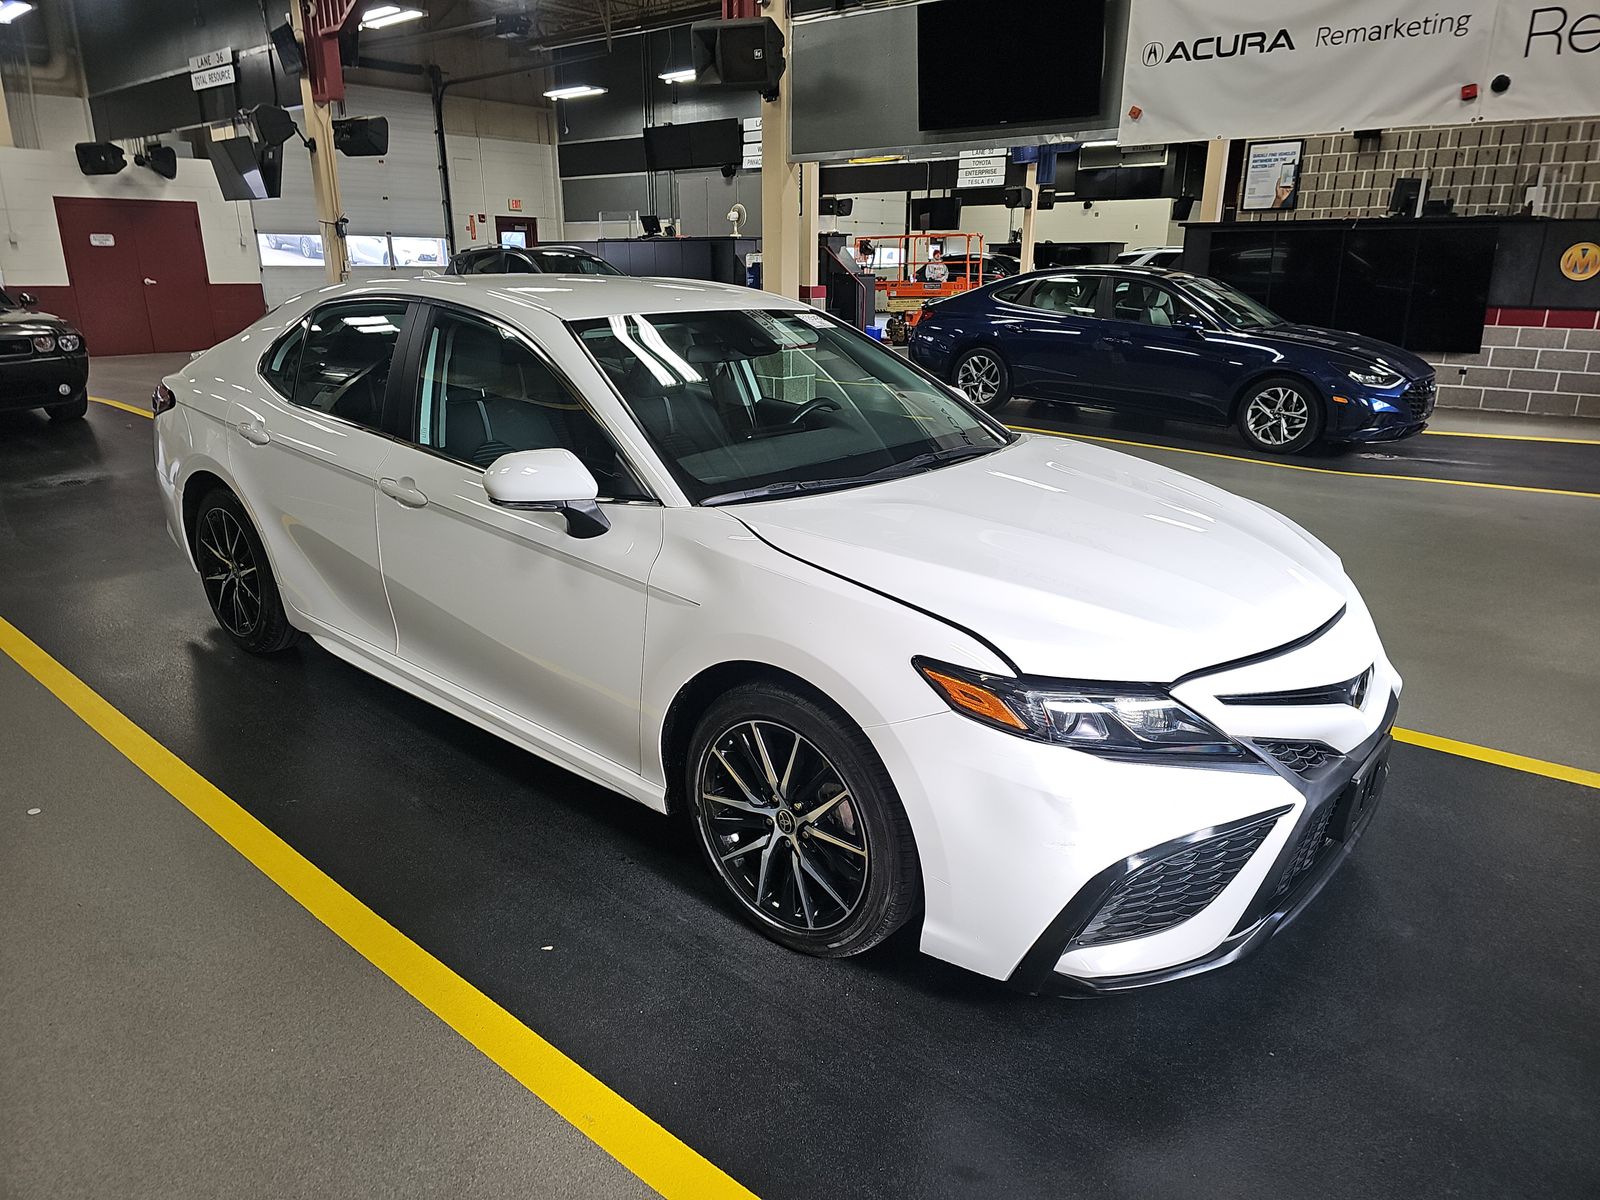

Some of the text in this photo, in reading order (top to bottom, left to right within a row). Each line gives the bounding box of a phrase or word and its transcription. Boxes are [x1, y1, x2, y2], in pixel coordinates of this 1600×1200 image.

[1165, 13, 1472, 63] ACURA Remarketing
[196, 51, 224, 68] LANE 36
[208, 69, 231, 83] RESOURCE
[965, 168, 998, 177] ENTERPRISE
